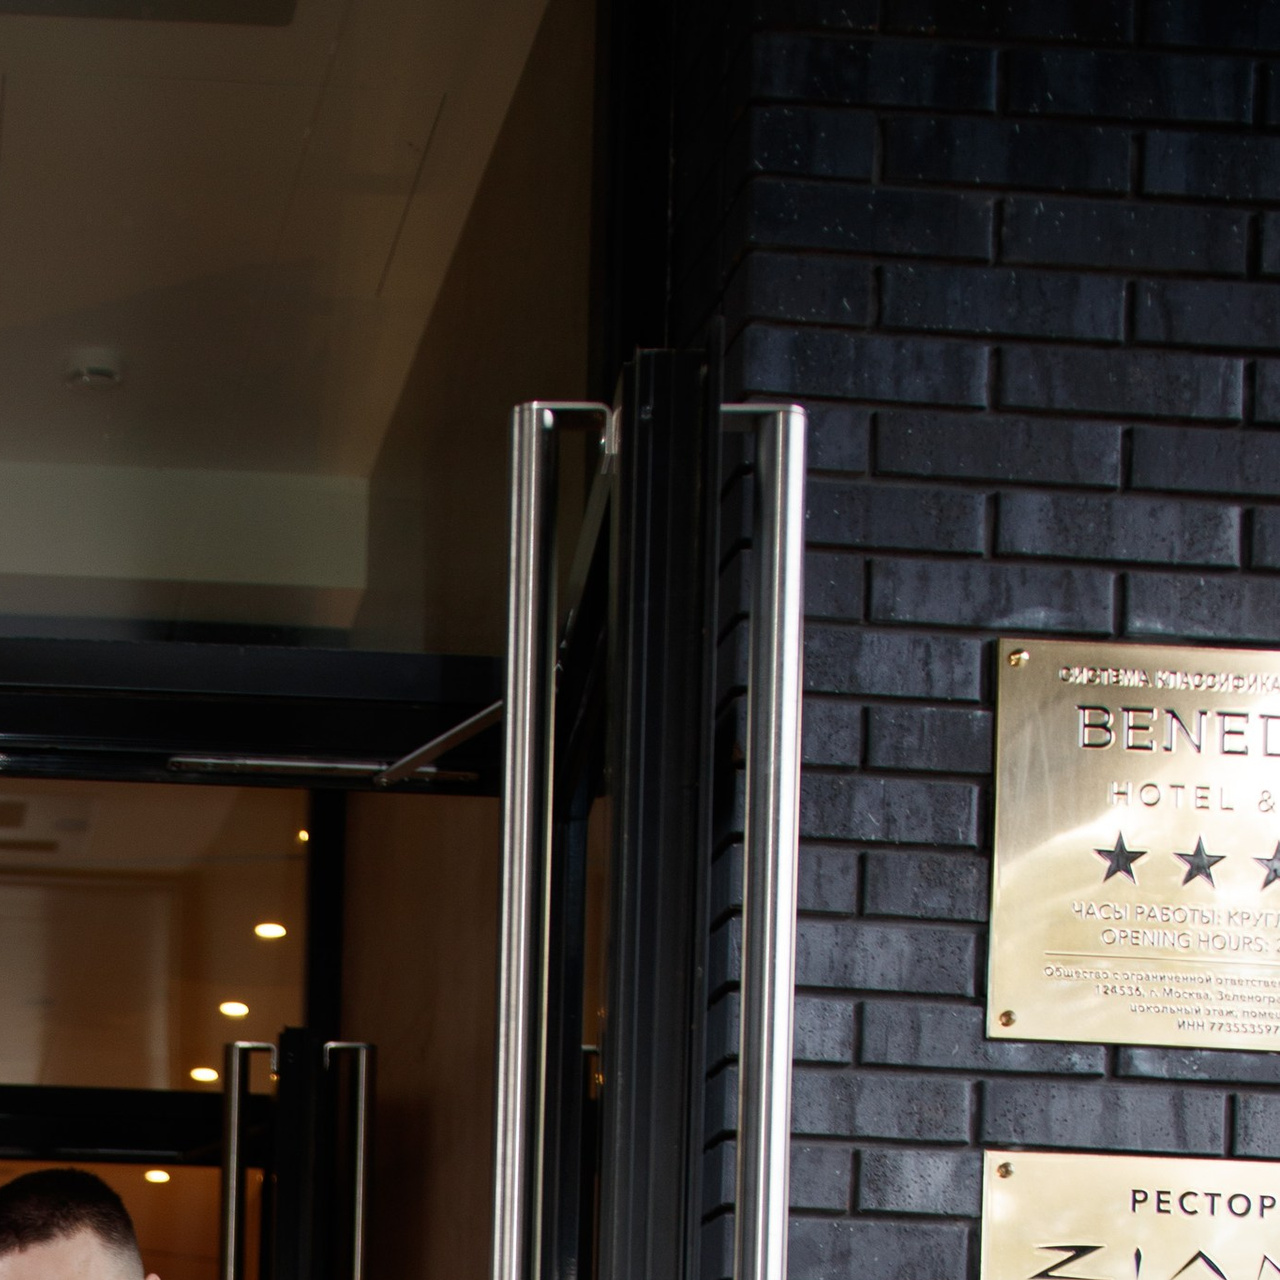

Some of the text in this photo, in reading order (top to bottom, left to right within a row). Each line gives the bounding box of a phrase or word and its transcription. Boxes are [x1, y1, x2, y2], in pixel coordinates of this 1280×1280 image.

[1059, 665, 1152, 688] СИСТЕМА
[1111, 782, 1276, 813] HOTEL &
[1073, 902, 1128, 920] ЧАСЫ
[1135, 906, 1221, 925] РАБОТЫ:
[1102, 928, 1191, 948] OPENING
[1198, 933, 1269, 953] HOURS:
[1044, 966, 1109, 980] Общество
[1177, 1020, 1206, 1031] ИНН
[1131, 1189, 1277, 1218] РЕСТОР
